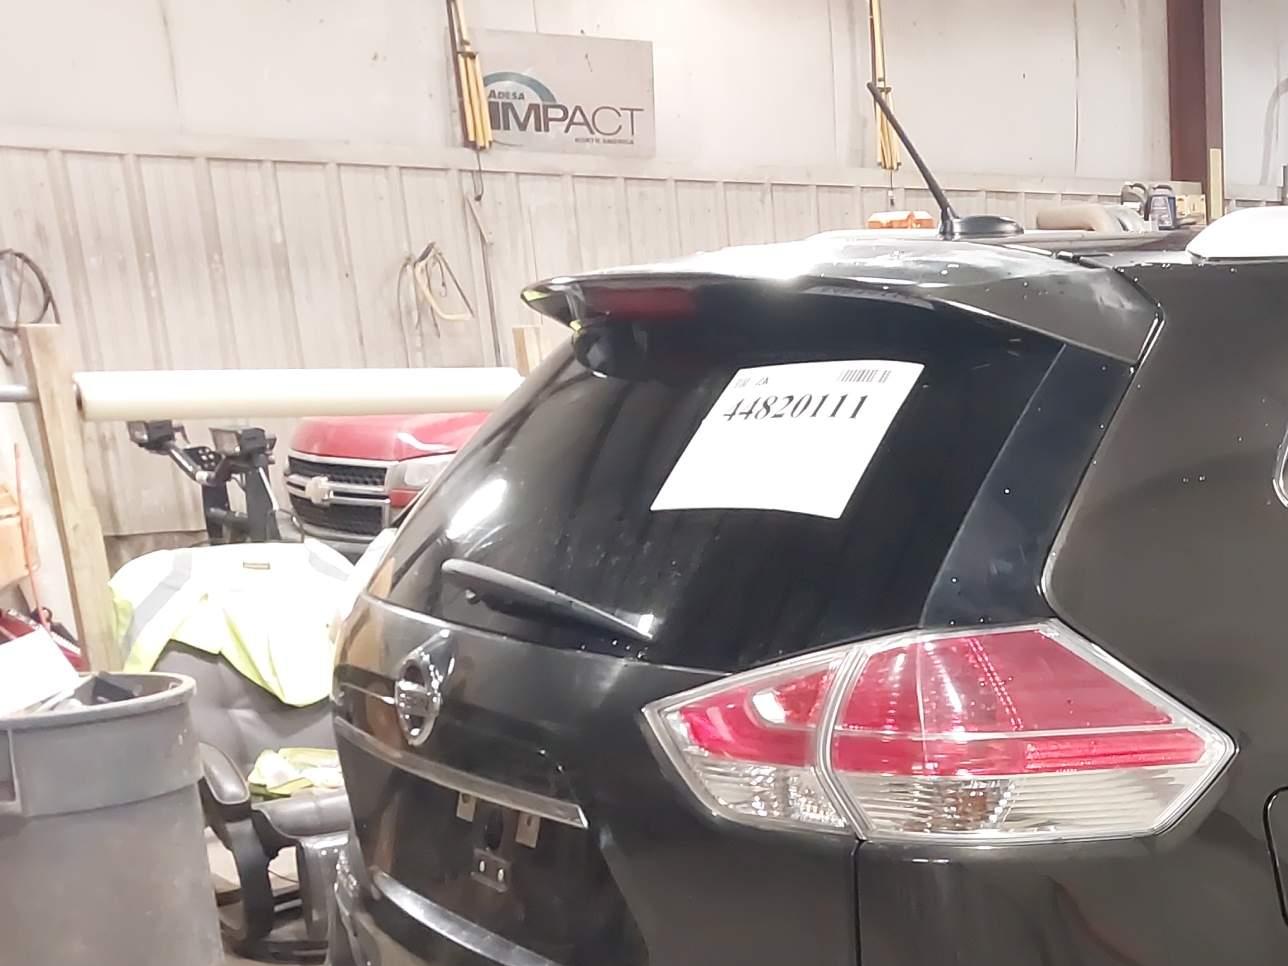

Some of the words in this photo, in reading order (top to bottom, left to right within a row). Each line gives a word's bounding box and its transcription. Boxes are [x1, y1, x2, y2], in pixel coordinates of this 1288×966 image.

[488, 89, 525, 100] ADESA
[488, 101, 644, 136] IMPACT
[723, 393, 868, 421] 44820111
